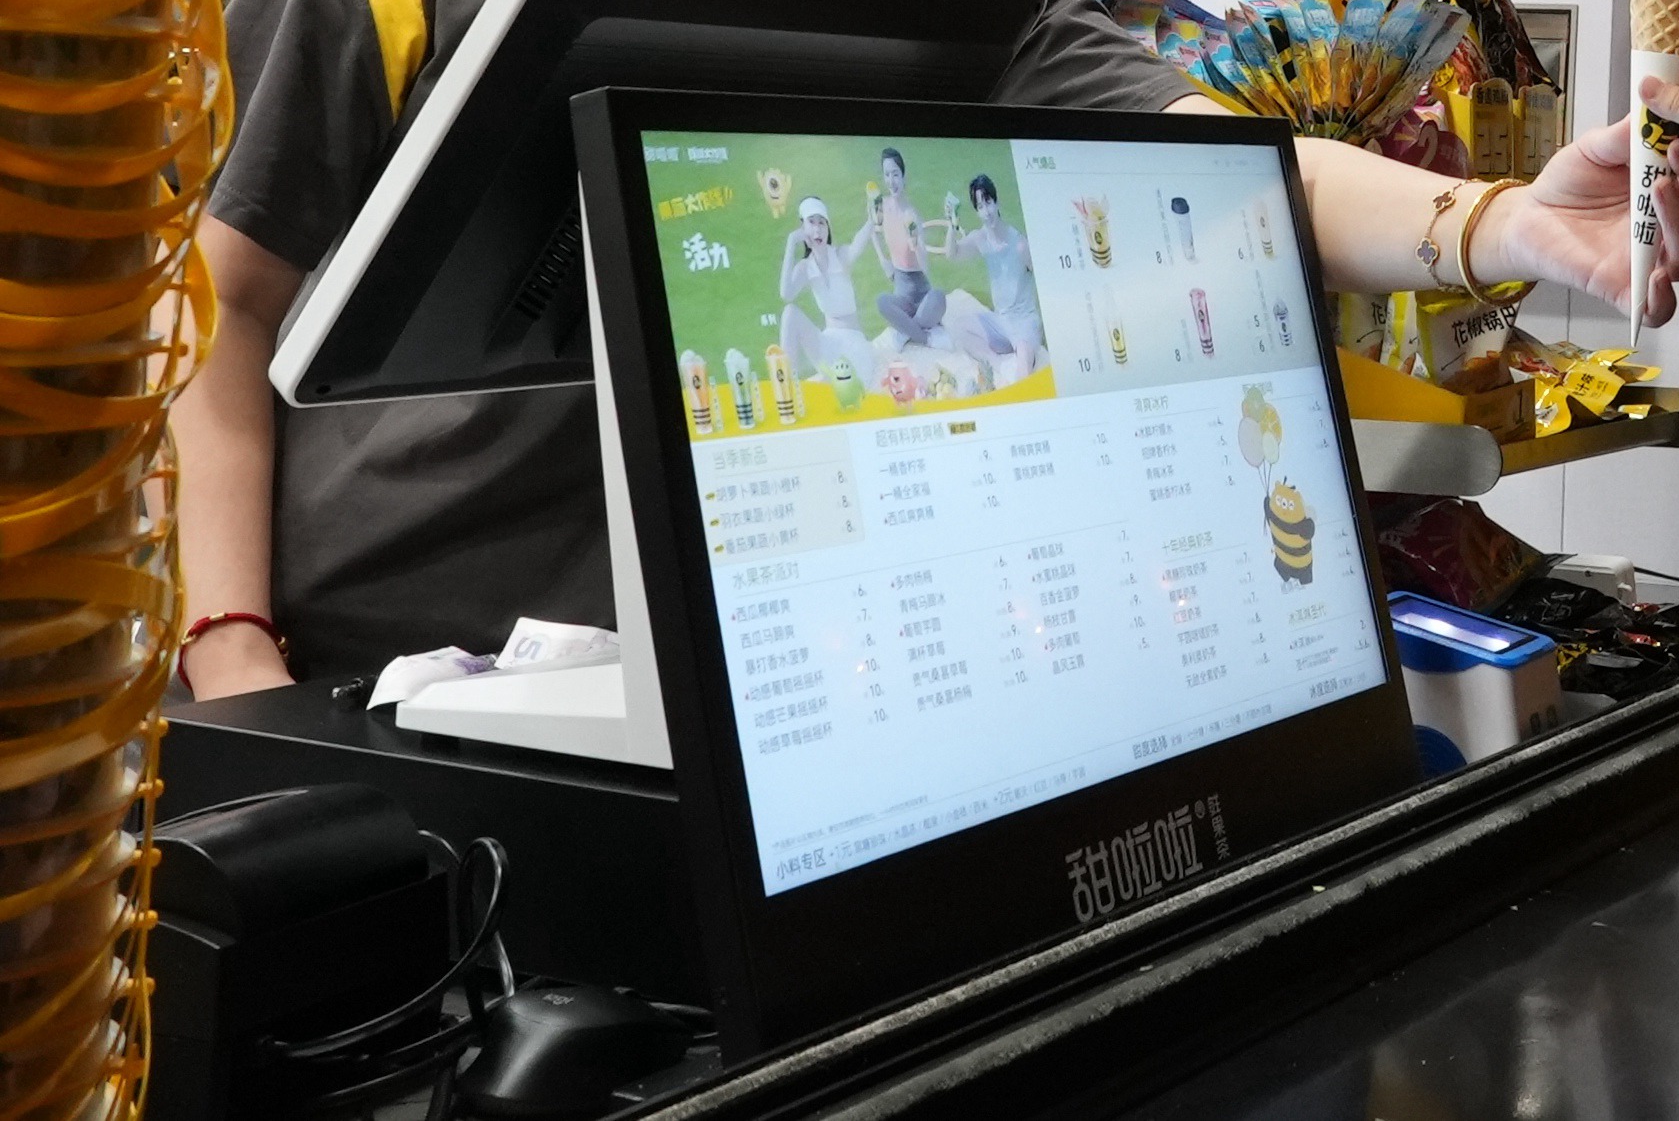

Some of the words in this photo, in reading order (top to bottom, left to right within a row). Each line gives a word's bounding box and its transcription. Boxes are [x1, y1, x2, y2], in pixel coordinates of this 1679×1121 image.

[682, 232, 731, 272] 活力
[1451, 305, 1517, 348] 花椒锅巴
[1065, 804, 1204, 923] 甜啦啦
